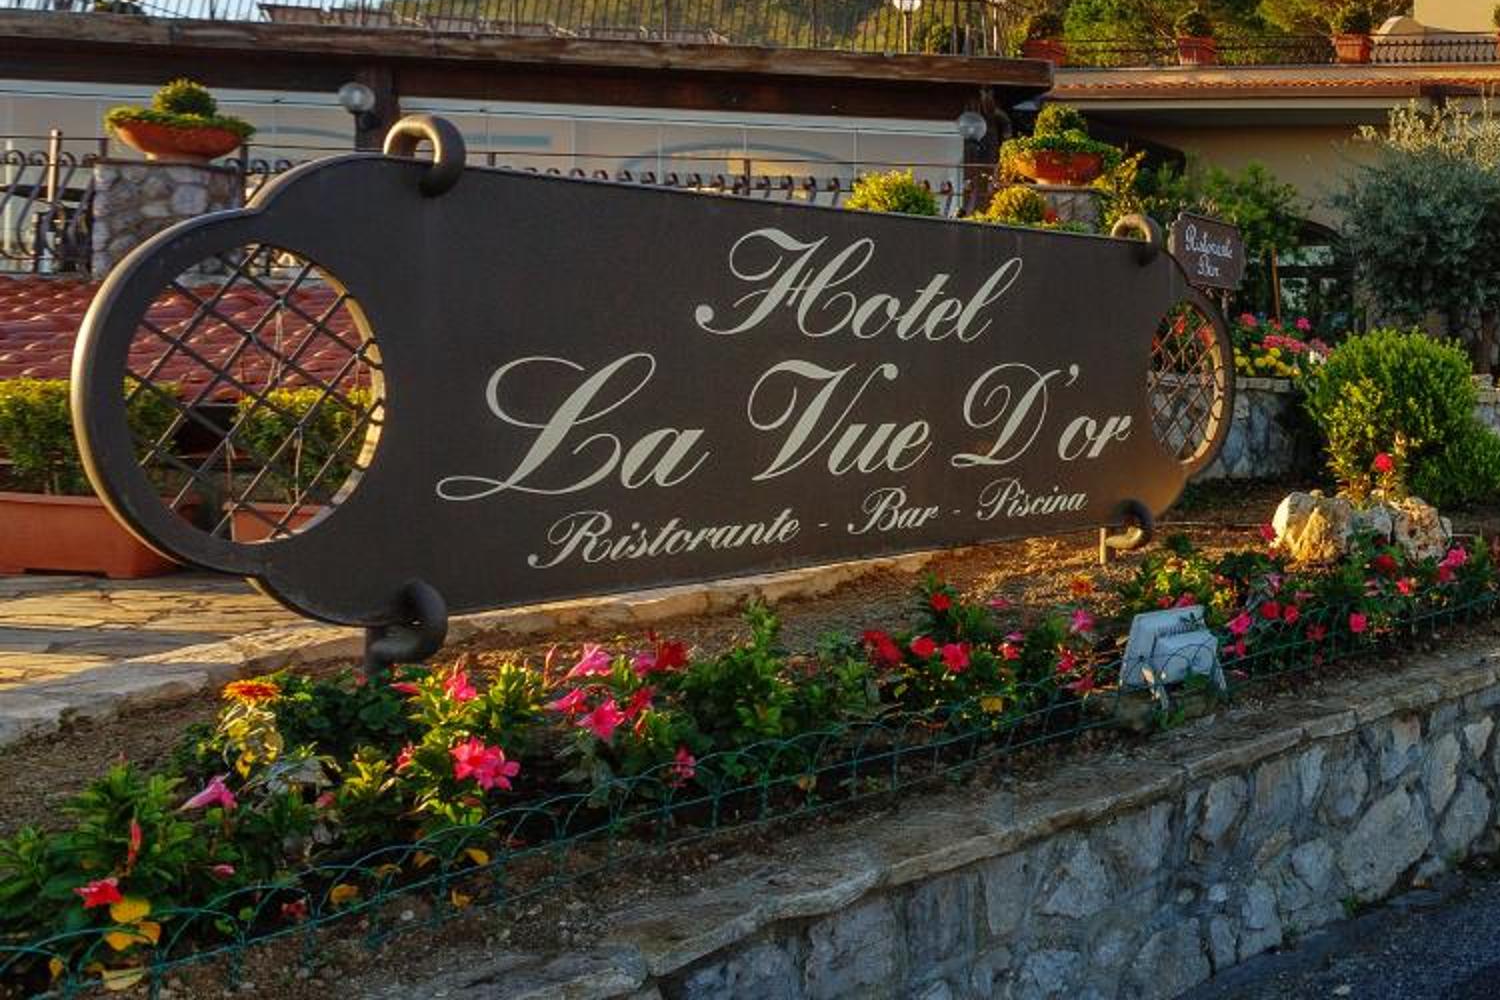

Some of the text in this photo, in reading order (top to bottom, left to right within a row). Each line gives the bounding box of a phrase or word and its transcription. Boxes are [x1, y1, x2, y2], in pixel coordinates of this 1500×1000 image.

[694, 227, 1024, 344] Hotel
[435, 352, 1132, 501] La Vue D'or
[526, 508, 801, 569] Ristorante
[847, 486, 940, 535] Bar
[976, 477, 1088, 521] Piscina
